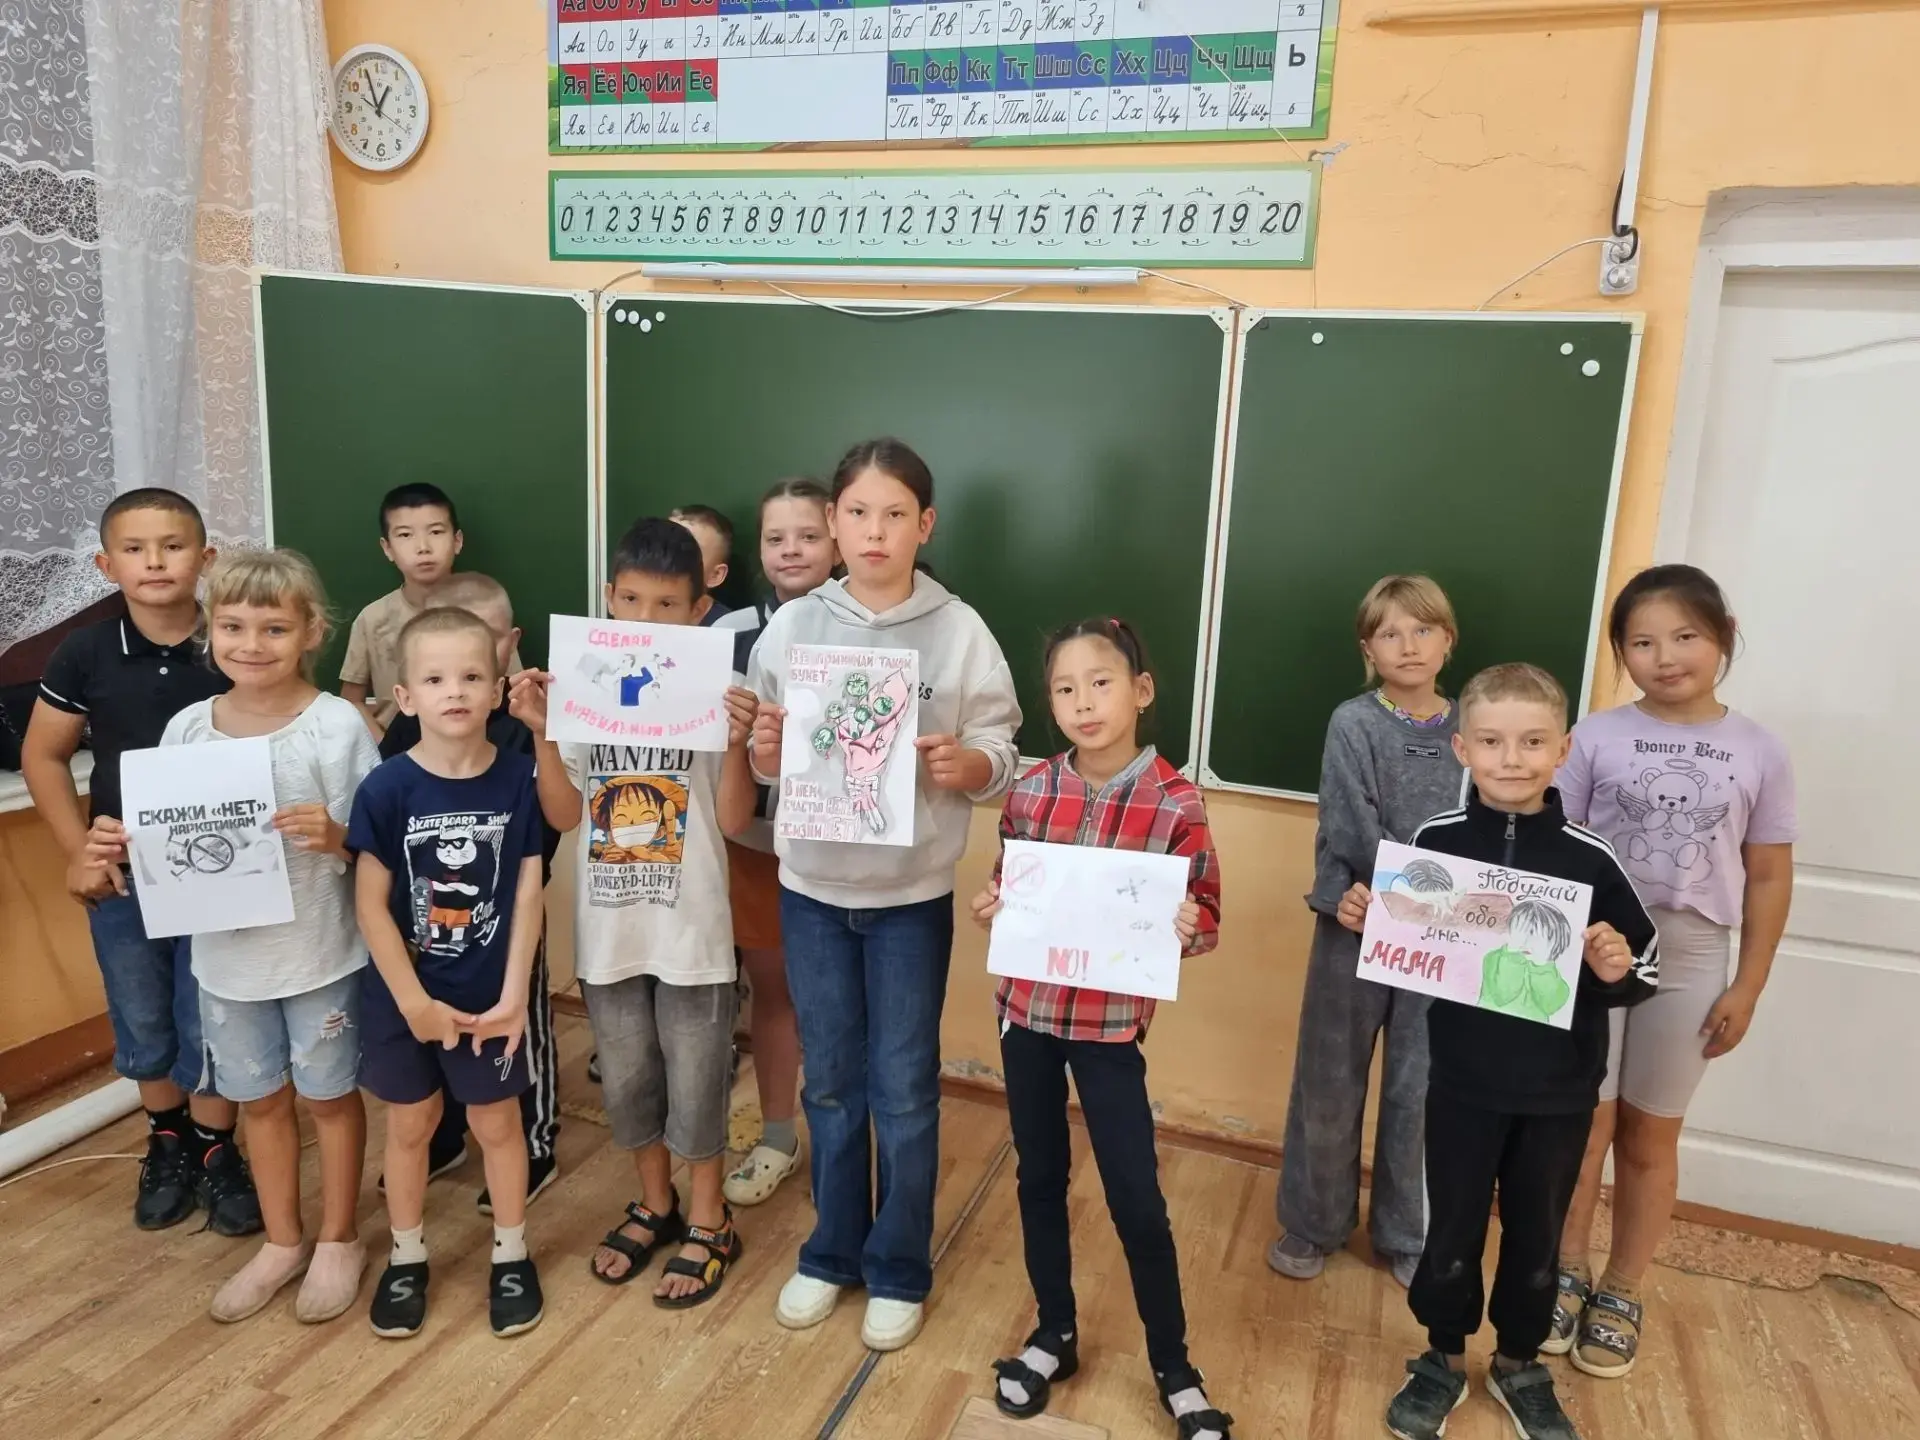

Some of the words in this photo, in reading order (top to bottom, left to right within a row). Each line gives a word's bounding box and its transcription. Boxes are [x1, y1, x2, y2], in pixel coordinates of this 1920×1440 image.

[564, 30, 585, 54] Аа
[597, 29, 614, 51] Оо
[625, 27, 648, 58] Уу
[693, 25, 711, 48] Ээ
[723, 23, 746, 47] Нн
[751, 21, 785, 46] Мм
[788, 20, 816, 43] Лл
[824, 18, 849, 52] Рр
[859, 16, 883, 41] Йй
[891, 14, 923, 39] Бб
[929, 11, 958, 37] Вв
[969, 9, 992, 35] Гг
[1002, 8, 1033, 41] Дд
[1037, 5, 1075, 31] Жж
[1082, 3, 1105, 35] Зз
[563, 75, 587, 96] Яя
[595, 68, 617, 94] Ёё
[622, 71, 652, 93] Юю
[656, 71, 681, 93] Ии
[689, 70, 713, 91] Ее
[891, 61, 919, 85] Пп
[924, 60, 959, 88] Фф
[966, 57, 992, 83] Кк
[1003, 56, 1029, 81] Тт
[1034, 54, 1072, 79] Шш
[1076, 51, 1106, 76] Сс
[1114, 50, 1148, 75] Хх
[1153, 48, 1188, 78] Цц
[1197, 47, 1228, 71] Чч
[1232, 45, 1275, 74] Щщ
[564, 113, 586, 136] Яя
[624, 111, 651, 134] Юю
[658, 111, 680, 133] Ии
[691, 113, 711, 133] Ее
[890, 103, 919, 128] Пп
[927, 103, 953, 135] Фф
[963, 101, 988, 126] Кк
[994, 99, 1030, 125] Тт
[1033, 98, 1067, 123] Шш
[1077, 96, 1099, 121] Сс
[1112, 95, 1143, 120] Хх
[1154, 95, 1180, 124] Цц
[1198, 92, 1219, 118] Чч
[1229, 92, 1270, 122] Щщ
[376, 142, 386, 157] 6
[560, 206, 573, 232] 0
[585, 206, 594, 232] 1
[606, 206, 619, 232] 2
[627, 206, 642, 232] 3
[651, 205, 664, 233] 4
[671, 205, 688, 233] 5
[696, 206, 711, 233] 6
[722, 206, 734, 233] 7
[745, 206, 760, 233] 8
[768, 206, 783, 233] 9
[796, 206, 826, 234] 10
[839, 206, 868, 234] 11
[882, 206, 913, 234] 12
[926, 205, 958, 234] 13
[972, 204, 1004, 234] 14
[1017, 204, 1050, 234] 15
[1065, 205, 1098, 234] 16
[1112, 204, 1147, 234] 17
[1162, 203, 1198, 234] 18
[1213, 203, 1249, 234] 19
[1260, 203, 1301, 233] 20
[590, 744, 694, 772] WANTED
[1633, 739, 1686, 756] Honey
[1694, 741, 1734, 763] Bear
[138, 804, 206, 826] СКАЖИ
[211, 799, 268, 817] «НЕТ»
[169, 816, 257, 836] НАРКОТИКАМ
[407, 815, 477, 833] SKATEBOARD
[592, 864, 615, 874] DEAD
[618, 865, 636, 874] OR
[641, 864, 677, 874] ALIVE
[1478, 868, 1578, 903] Подумай
[1465, 904, 1497, 929] обо
[1046, 946, 1090, 983] NO!
[494, 1056, 513, 1081] 7
[389, 1276, 414, 1303] S
[499, 1273, 524, 1297] S
